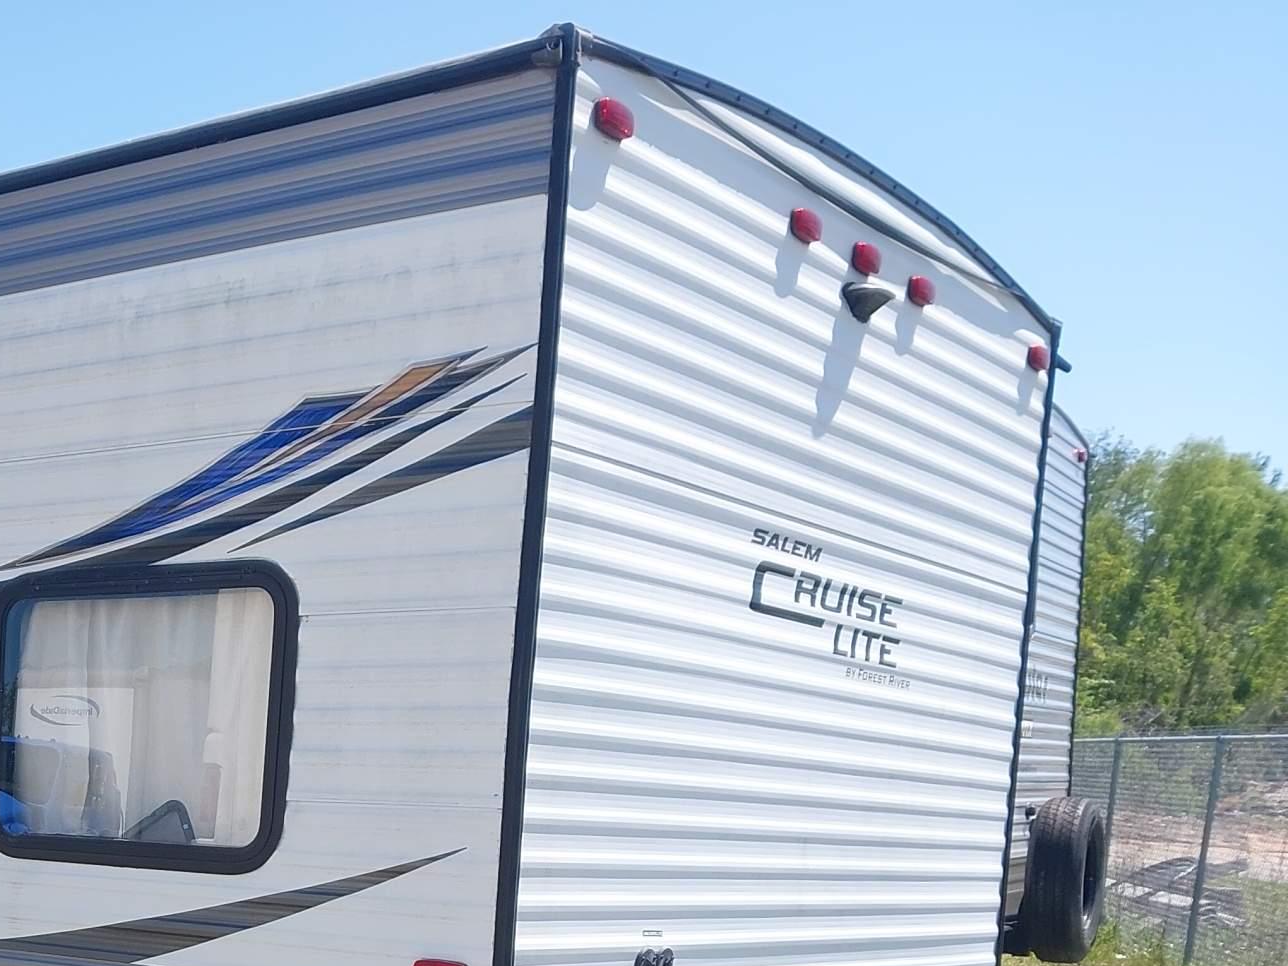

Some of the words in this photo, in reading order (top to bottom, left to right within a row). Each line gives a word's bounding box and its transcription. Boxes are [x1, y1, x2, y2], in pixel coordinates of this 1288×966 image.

[751, 527, 823, 562] SALEM
[749, 560, 903, 628] CRUISE
[832, 623, 901, 668] LITE
[846, 667, 857, 679] BY
[858, 668, 887, 685] FOREST
[888, 675, 911, 690] RIVER
